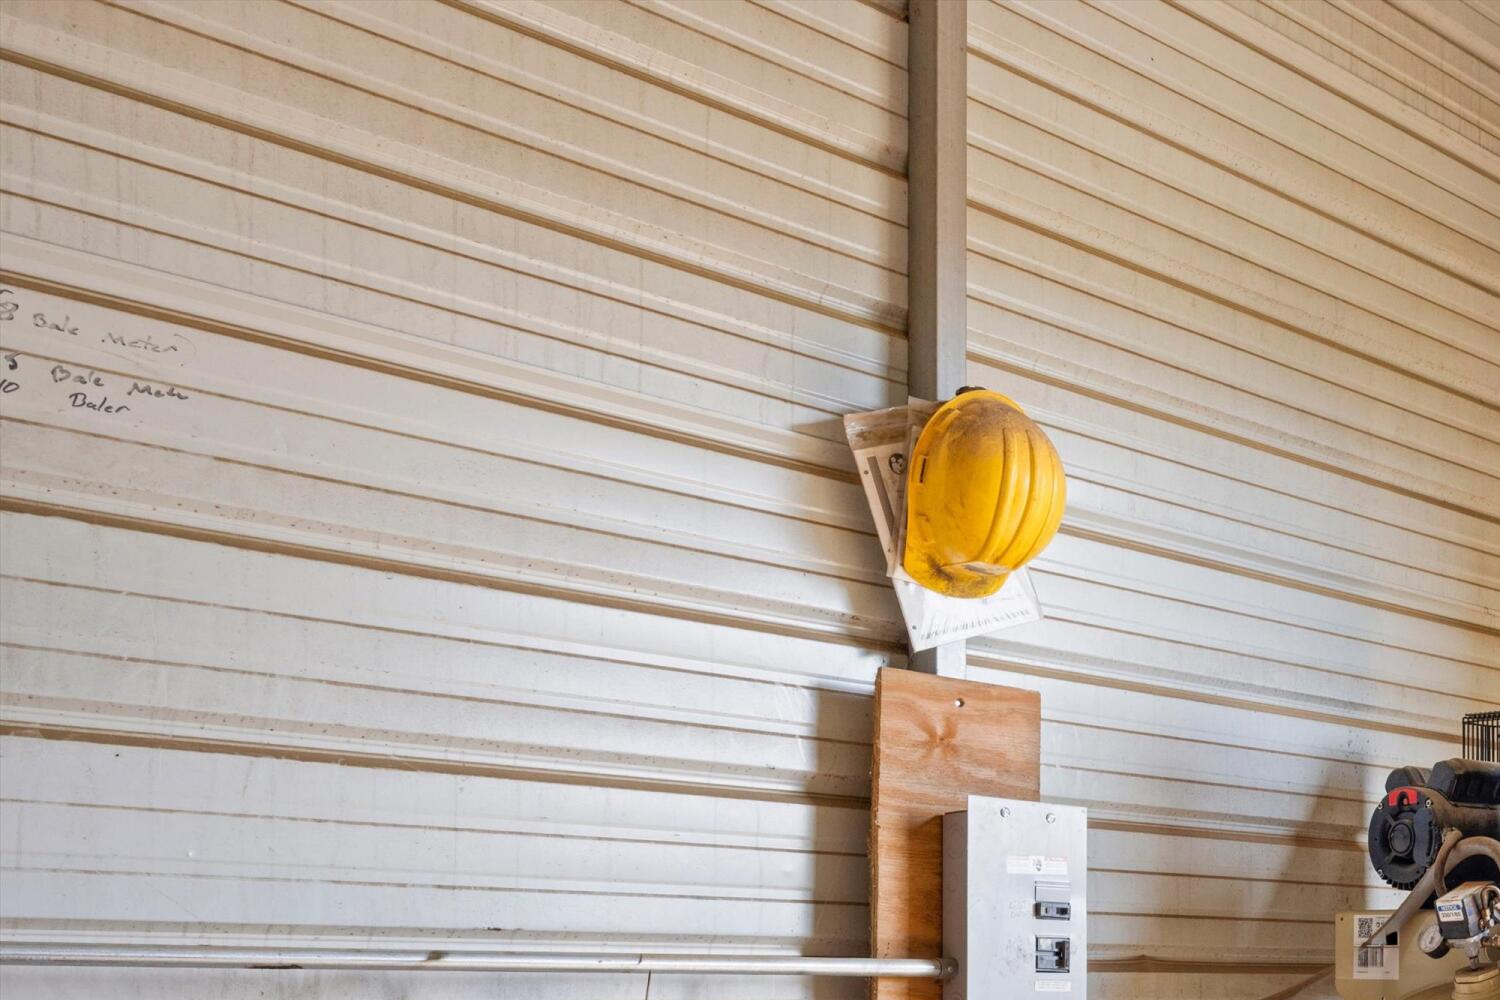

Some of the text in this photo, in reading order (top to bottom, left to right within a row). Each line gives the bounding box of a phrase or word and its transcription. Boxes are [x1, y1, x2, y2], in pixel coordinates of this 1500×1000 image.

[33, 313, 80, 336] Bale
[51, 365, 105, 388] Bale
[69, 392, 131, 414] Baler
